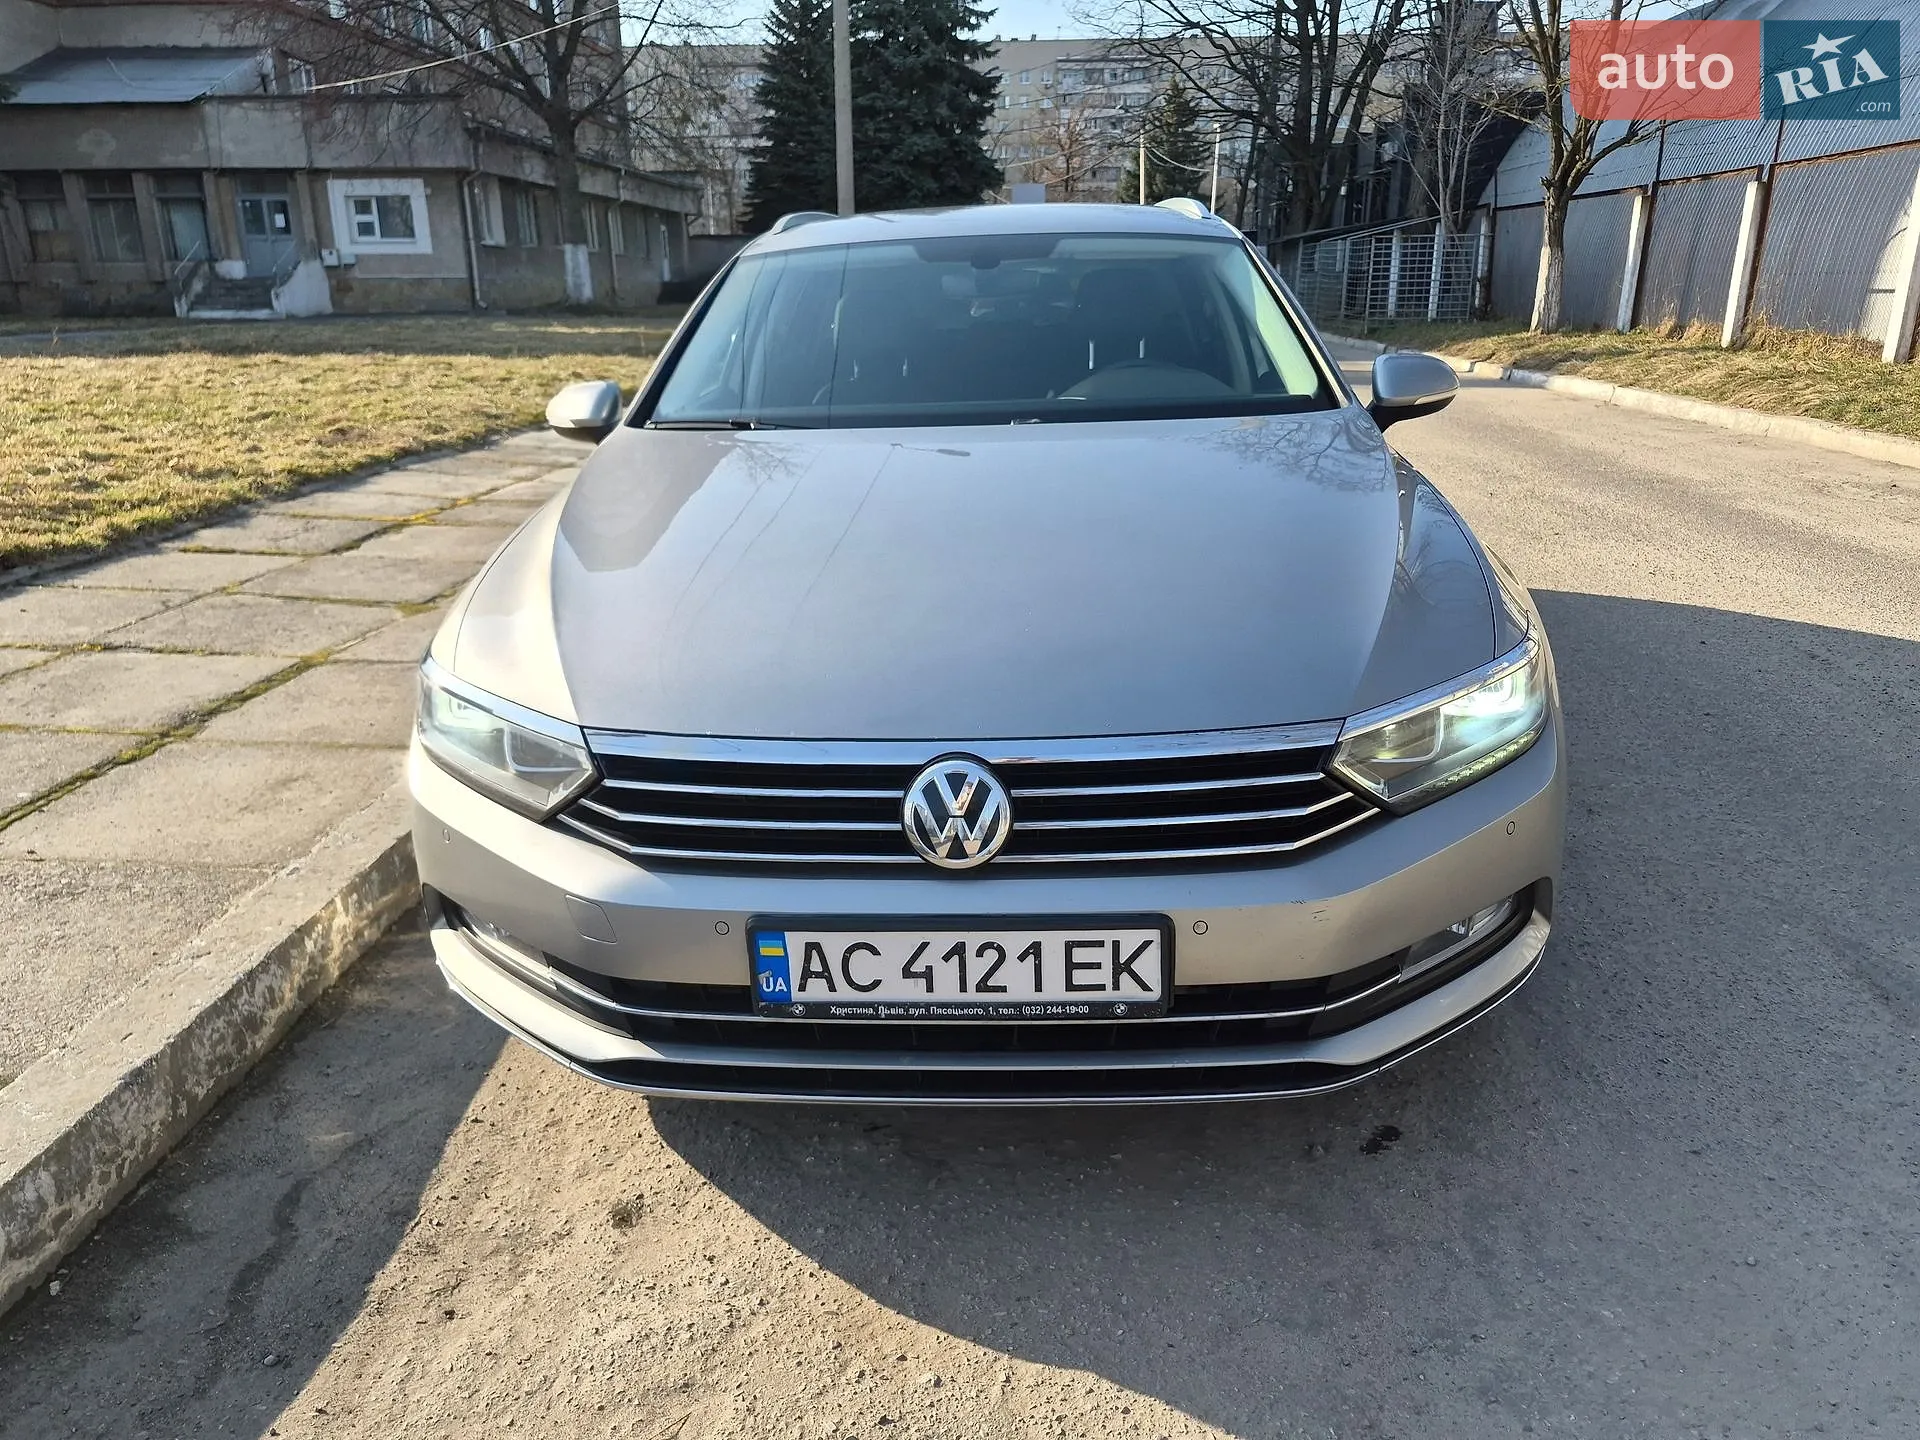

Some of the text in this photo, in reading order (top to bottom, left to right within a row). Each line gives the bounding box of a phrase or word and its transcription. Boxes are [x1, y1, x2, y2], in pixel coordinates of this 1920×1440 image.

[797, 939, 1155, 993] AC 4121 EK
[762, 976, 788, 992] UA
[830, 1005, 876, 1016] Христина,
[1022, 1005, 1045, 1016] (032)
[1046, 1005, 1089, 1014] 244-19-00
